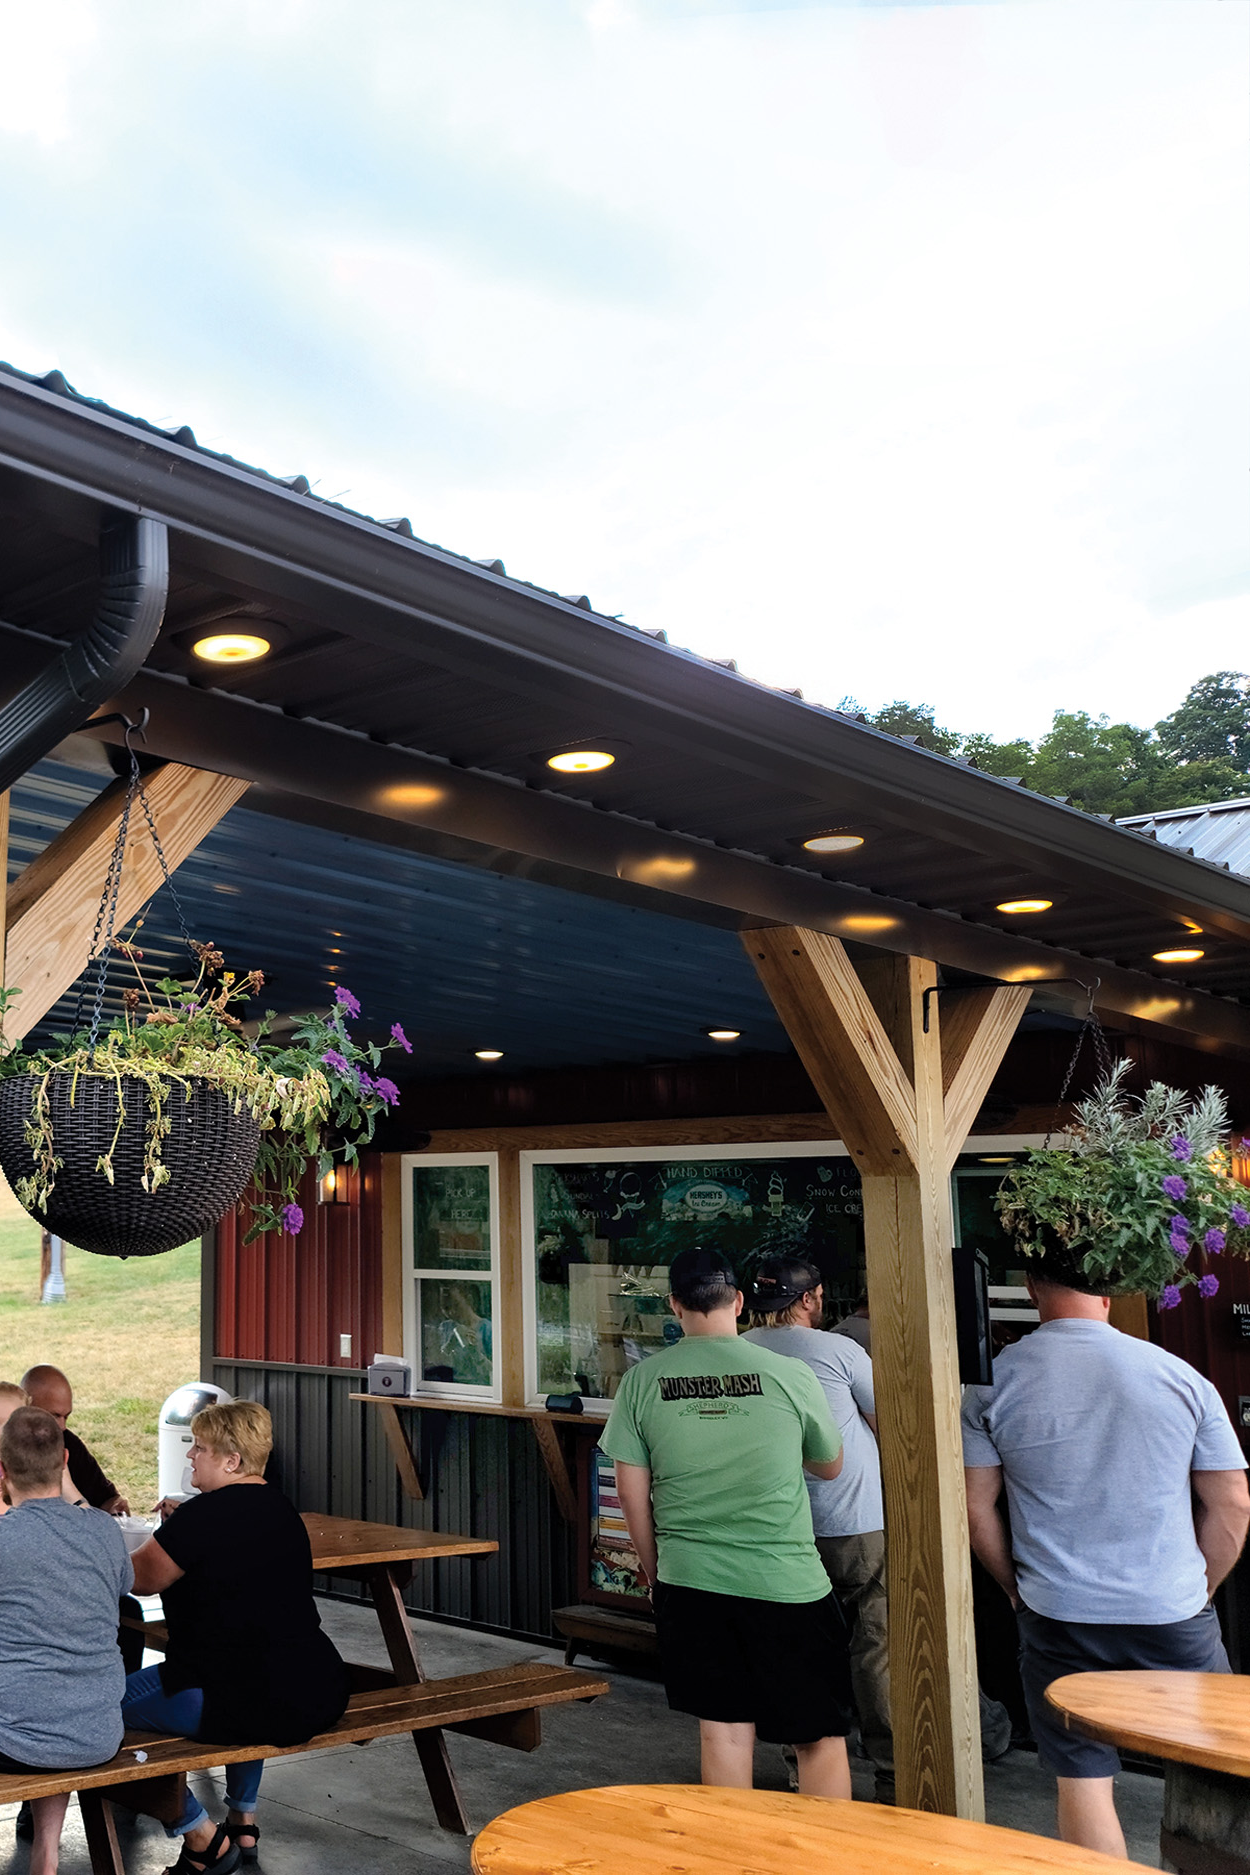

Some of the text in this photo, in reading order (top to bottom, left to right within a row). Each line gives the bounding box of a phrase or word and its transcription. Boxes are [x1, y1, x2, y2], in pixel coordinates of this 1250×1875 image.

[666, 1167, 698, 1179] HAND
[689, 1191, 723, 1200] HERSHEY'S
[659, 1374, 764, 1400] MUNSTER MASH
